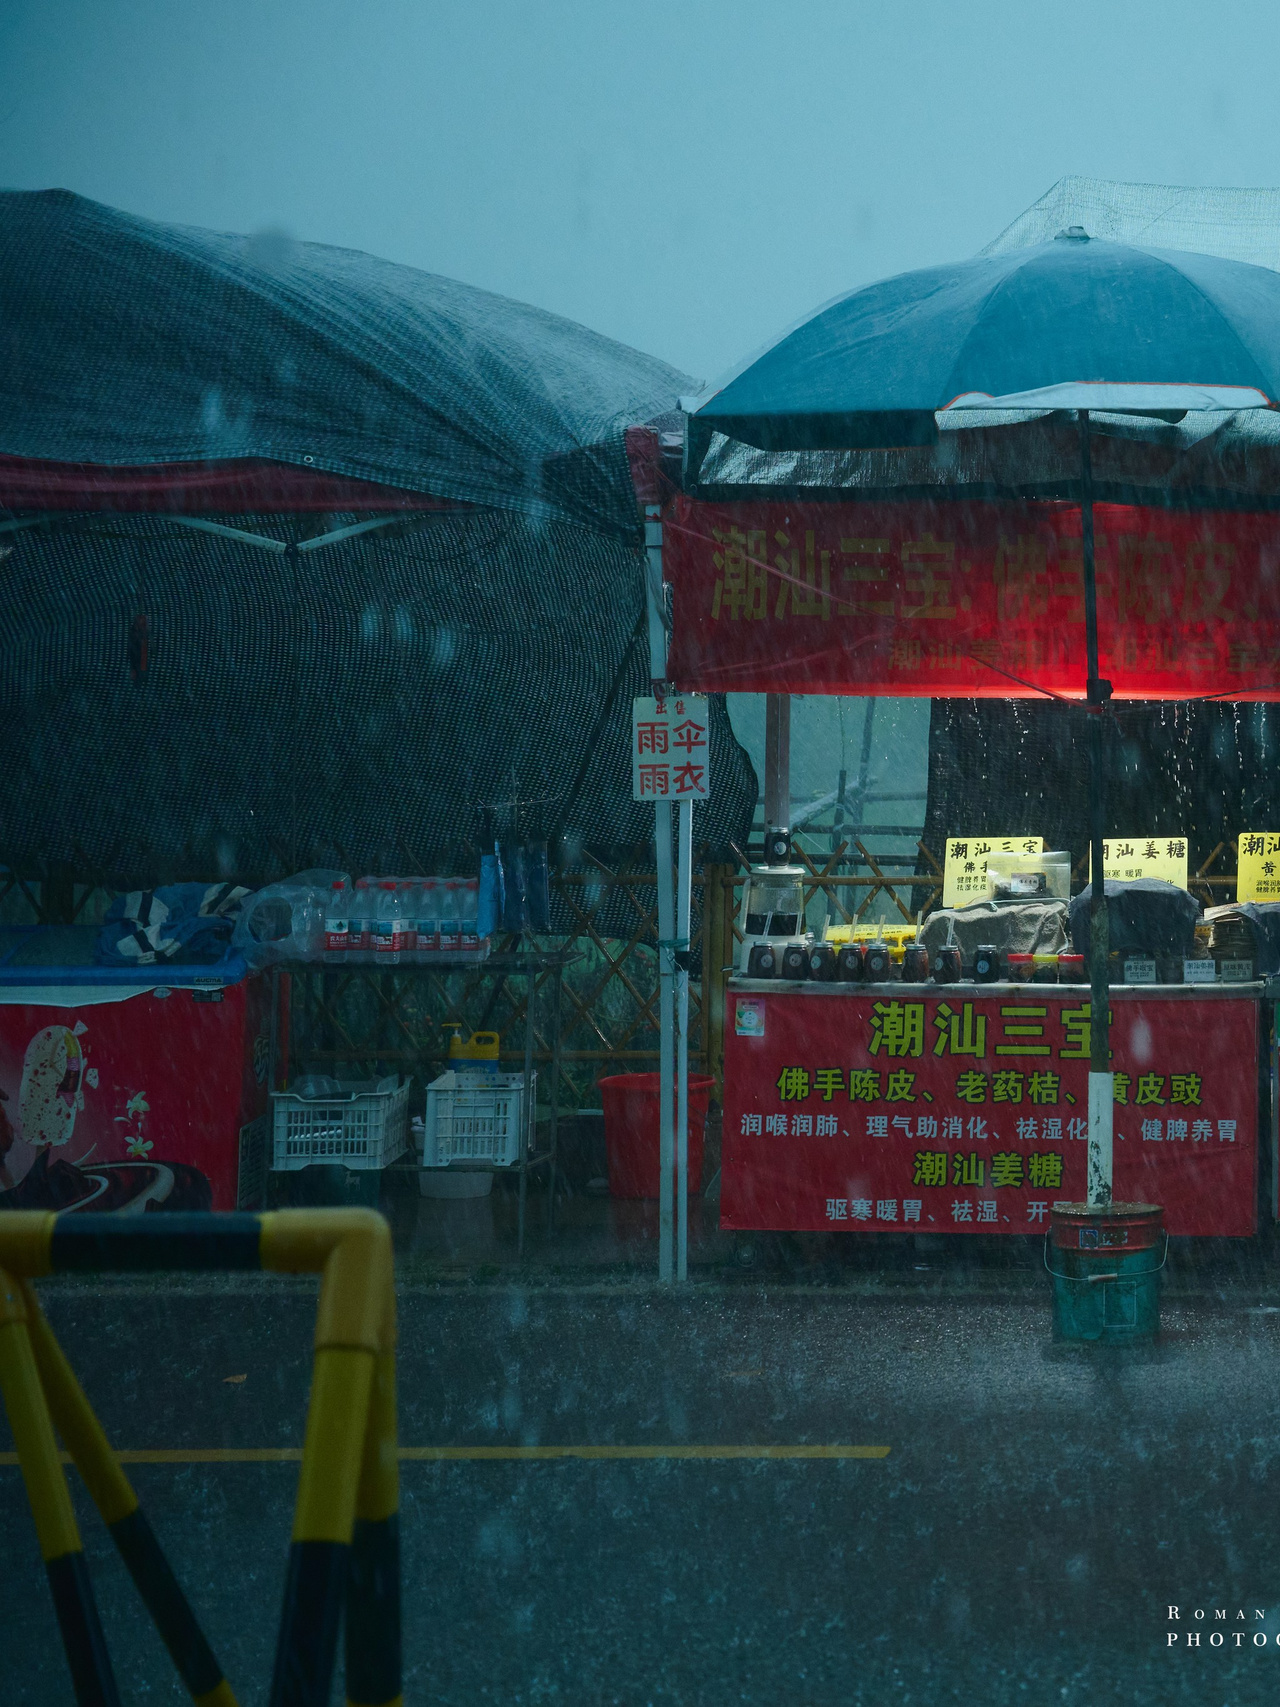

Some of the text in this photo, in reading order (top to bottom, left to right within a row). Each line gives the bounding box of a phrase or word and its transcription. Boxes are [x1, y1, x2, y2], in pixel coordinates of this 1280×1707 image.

[887, 637, 1045, 671] 潮汕姜糖
[655, 700, 686, 715] 出售
[637, 719, 707, 754] 雨伞
[638, 761, 706, 795] 雨衣
[950, 839, 1038, 859] 潮汕三宝
[868, 1000, 1113, 1058] 潮汕三宝
[740, 1113, 1238, 1143] 润喉润肺、理气助消化、祛湿化、健脾养胃
[912, 1152, 1064, 1188] 潮汕姜糖
